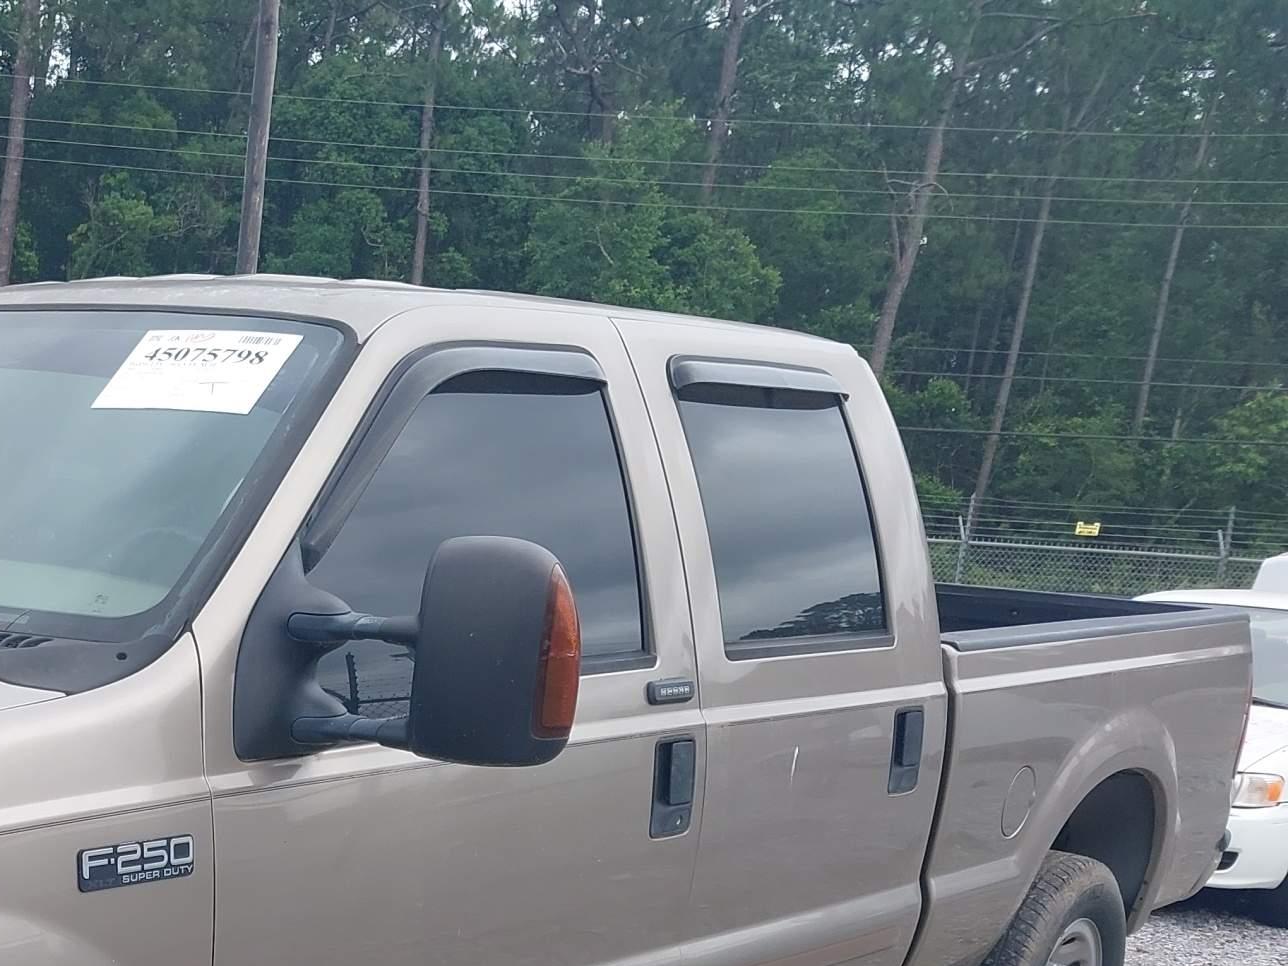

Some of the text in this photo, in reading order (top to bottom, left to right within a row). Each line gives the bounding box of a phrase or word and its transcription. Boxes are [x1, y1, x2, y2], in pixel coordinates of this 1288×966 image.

[144, 347, 269, 365] 45075798
[82, 836, 193, 880] F-250
[122, 865, 193, 884] SUPER DUTY
